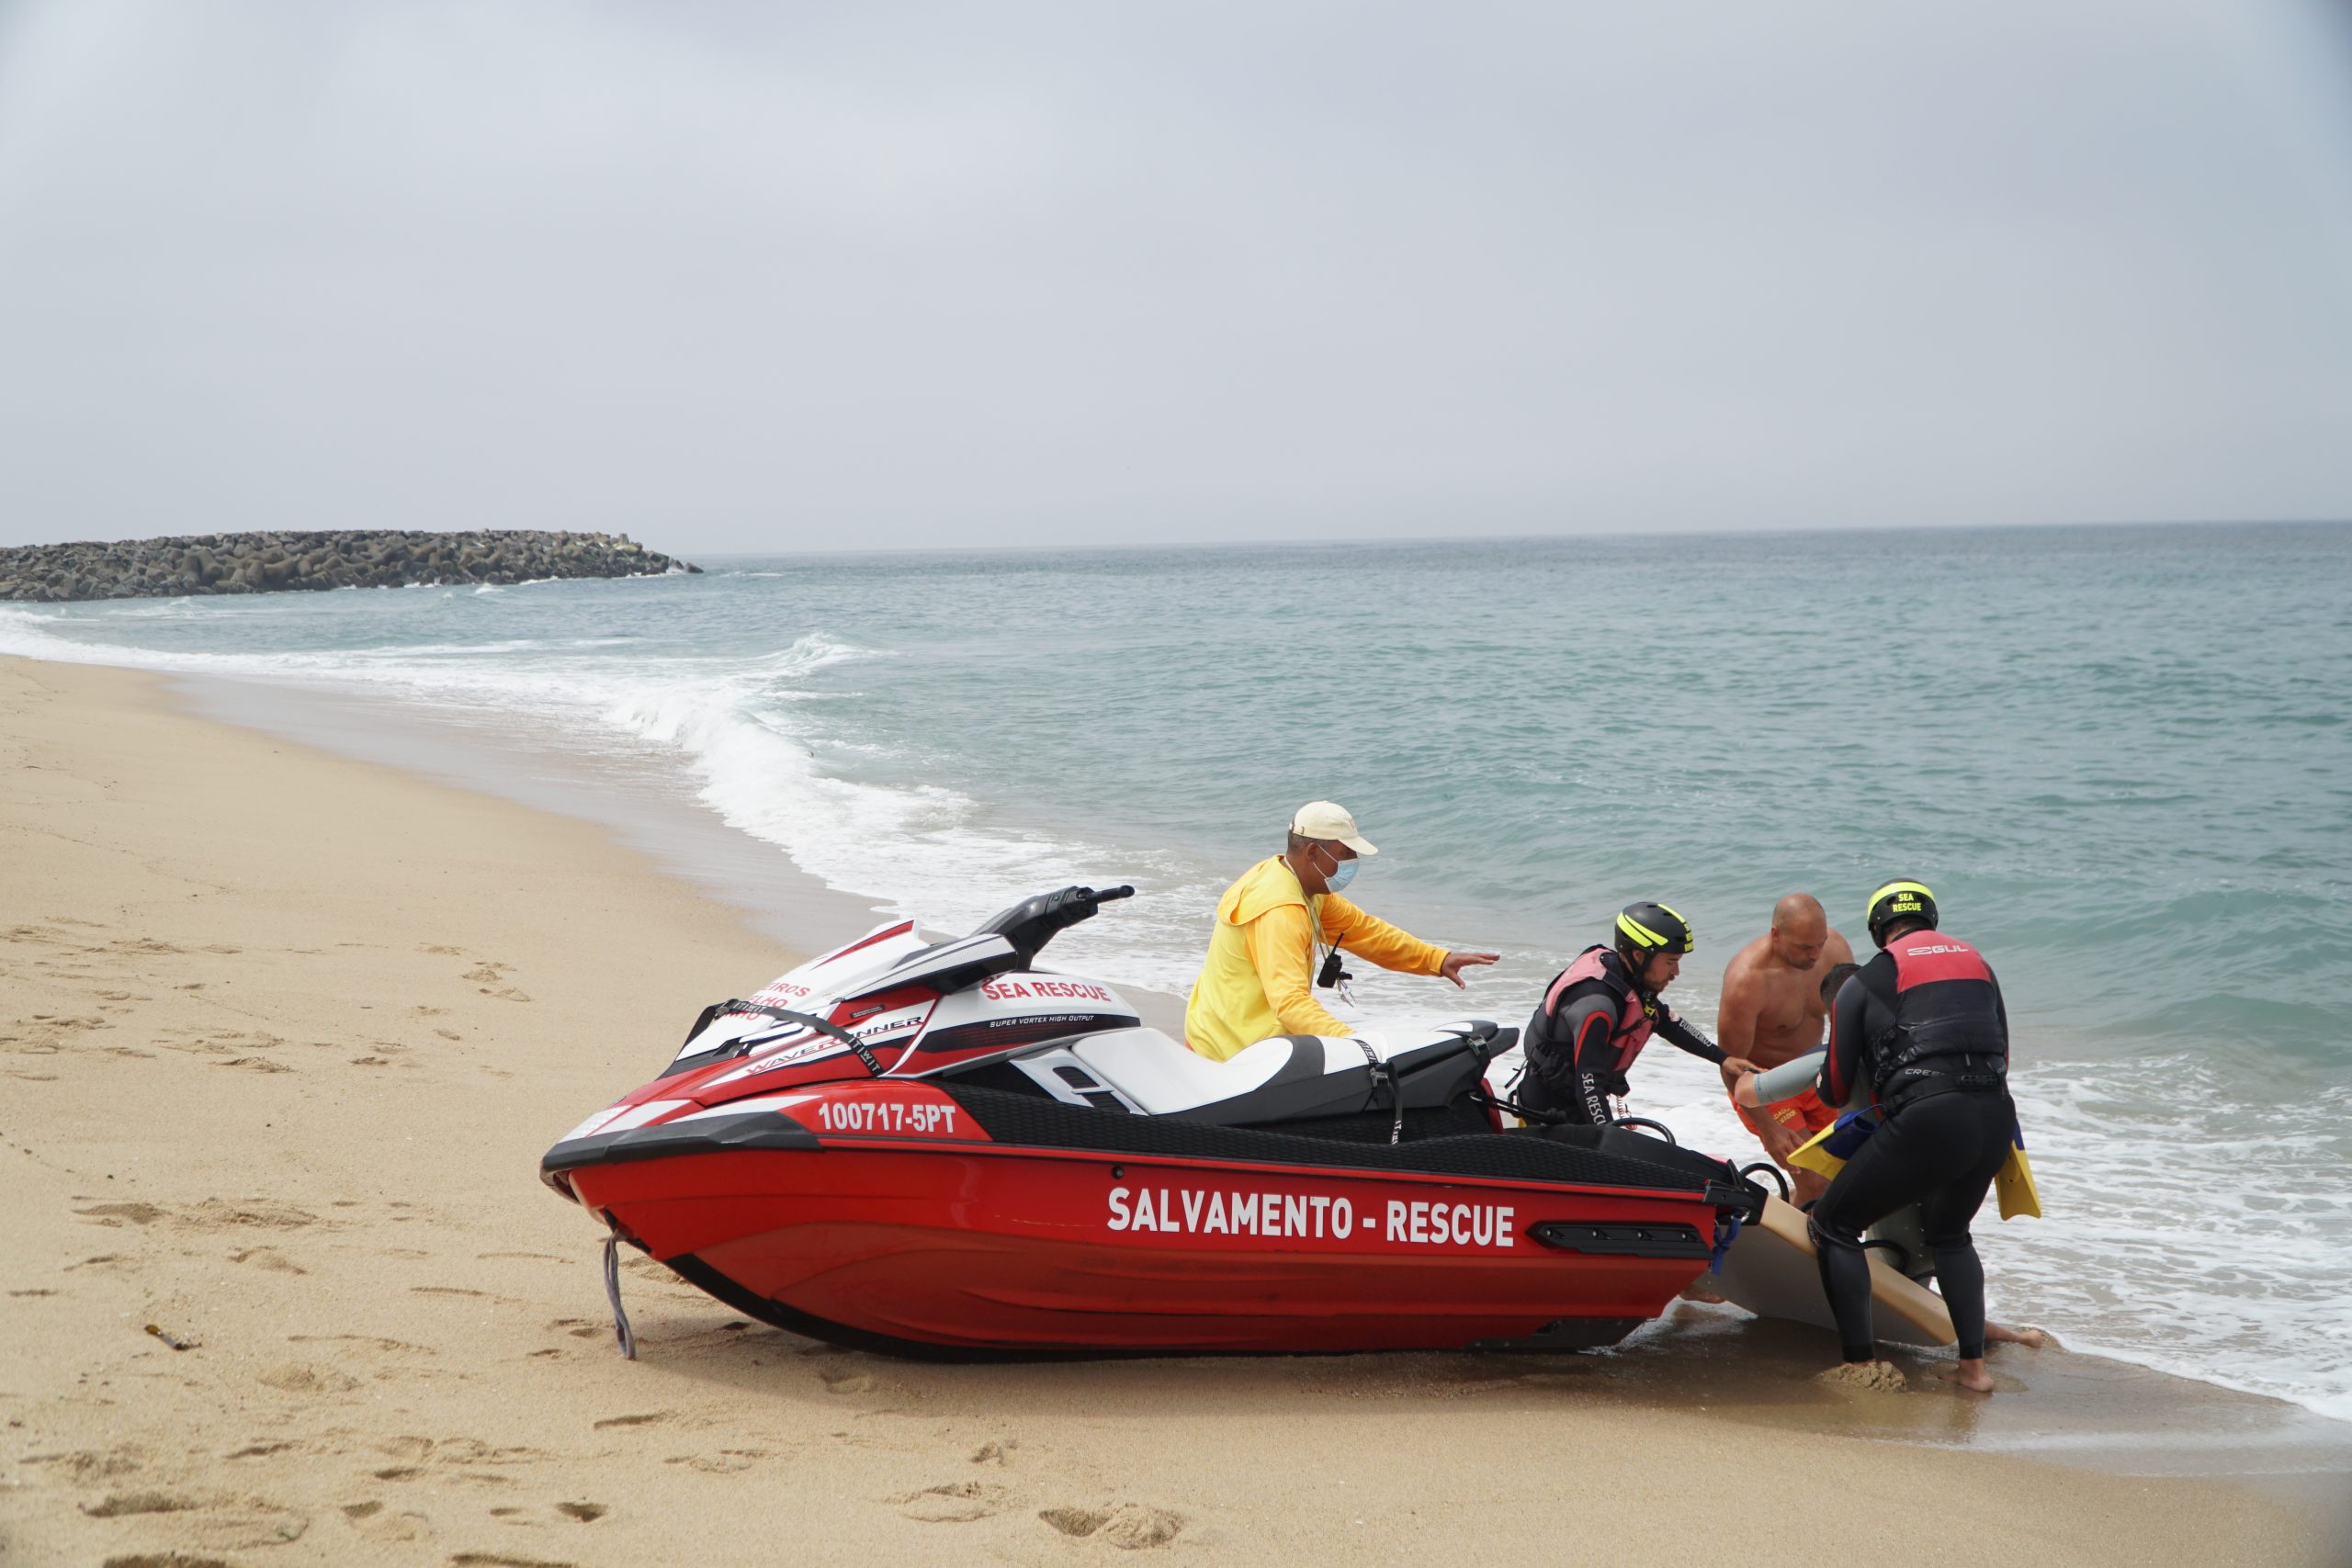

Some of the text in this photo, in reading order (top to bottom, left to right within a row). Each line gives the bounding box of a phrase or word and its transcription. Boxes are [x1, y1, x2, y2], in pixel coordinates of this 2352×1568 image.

[1893, 902, 1921, 912] RESCUE
[1898, 893, 1914, 902] SEA
[1932, 944, 1969, 953] GUL
[982, 981, 1112, 1003] SEA RESCUE
[989, 1018, 1017, 1028] SUPER
[1019, 1016, 1047, 1024] VORTEX
[1069, 1014, 1094, 1022] OUTPUT
[745, 1016, 922, 1075] WAVERNNER
[1581, 1073, 1596, 1095] SEA
[818, 1102, 956, 1134] 100717-5PT
[1106, 1186, 1515, 1247] SALVAMENTO - RESCUE
